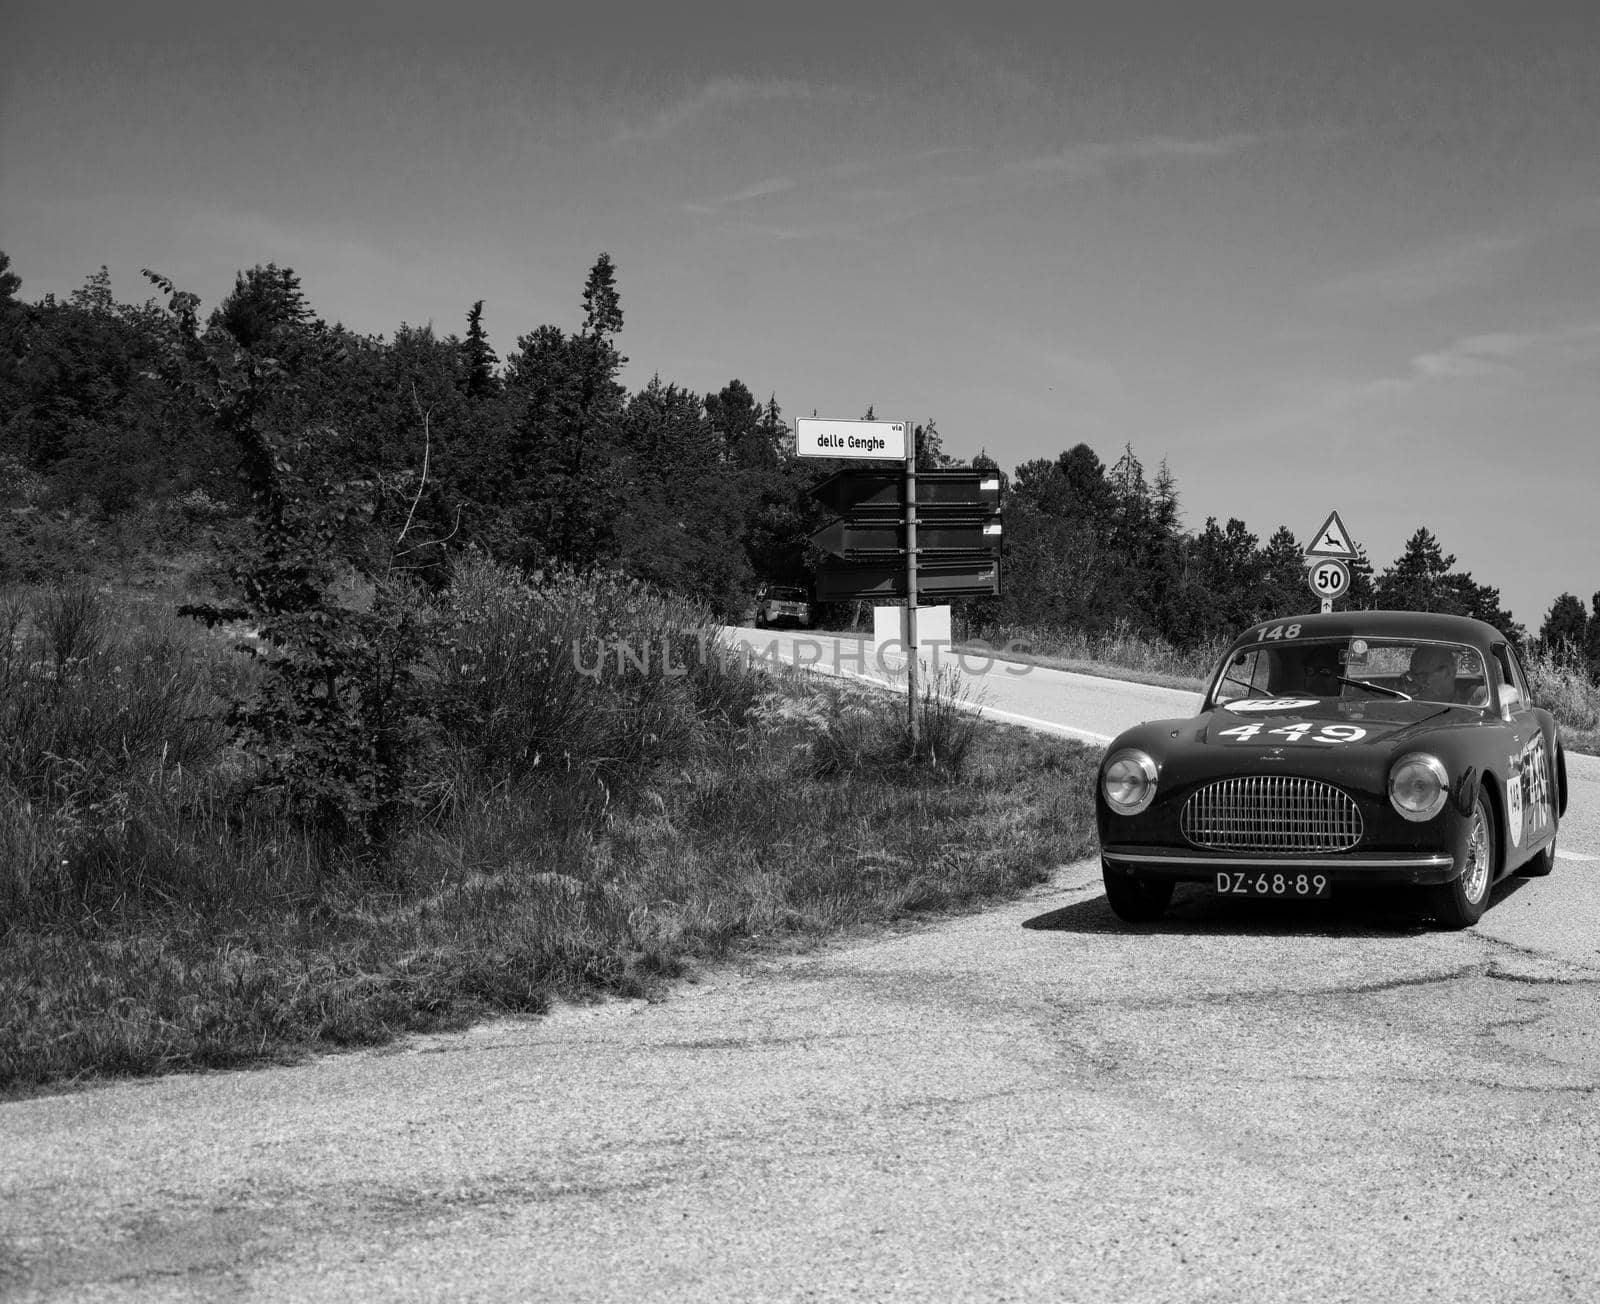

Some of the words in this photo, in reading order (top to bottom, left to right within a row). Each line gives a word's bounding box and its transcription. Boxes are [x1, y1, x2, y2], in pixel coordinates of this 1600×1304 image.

[817, 434, 844, 448] delle
[848, 435, 885, 452] Genghe
[1318, 570, 1341, 589] 50
[1257, 623, 1302, 641] 148
[1218, 723, 1367, 743] 449
